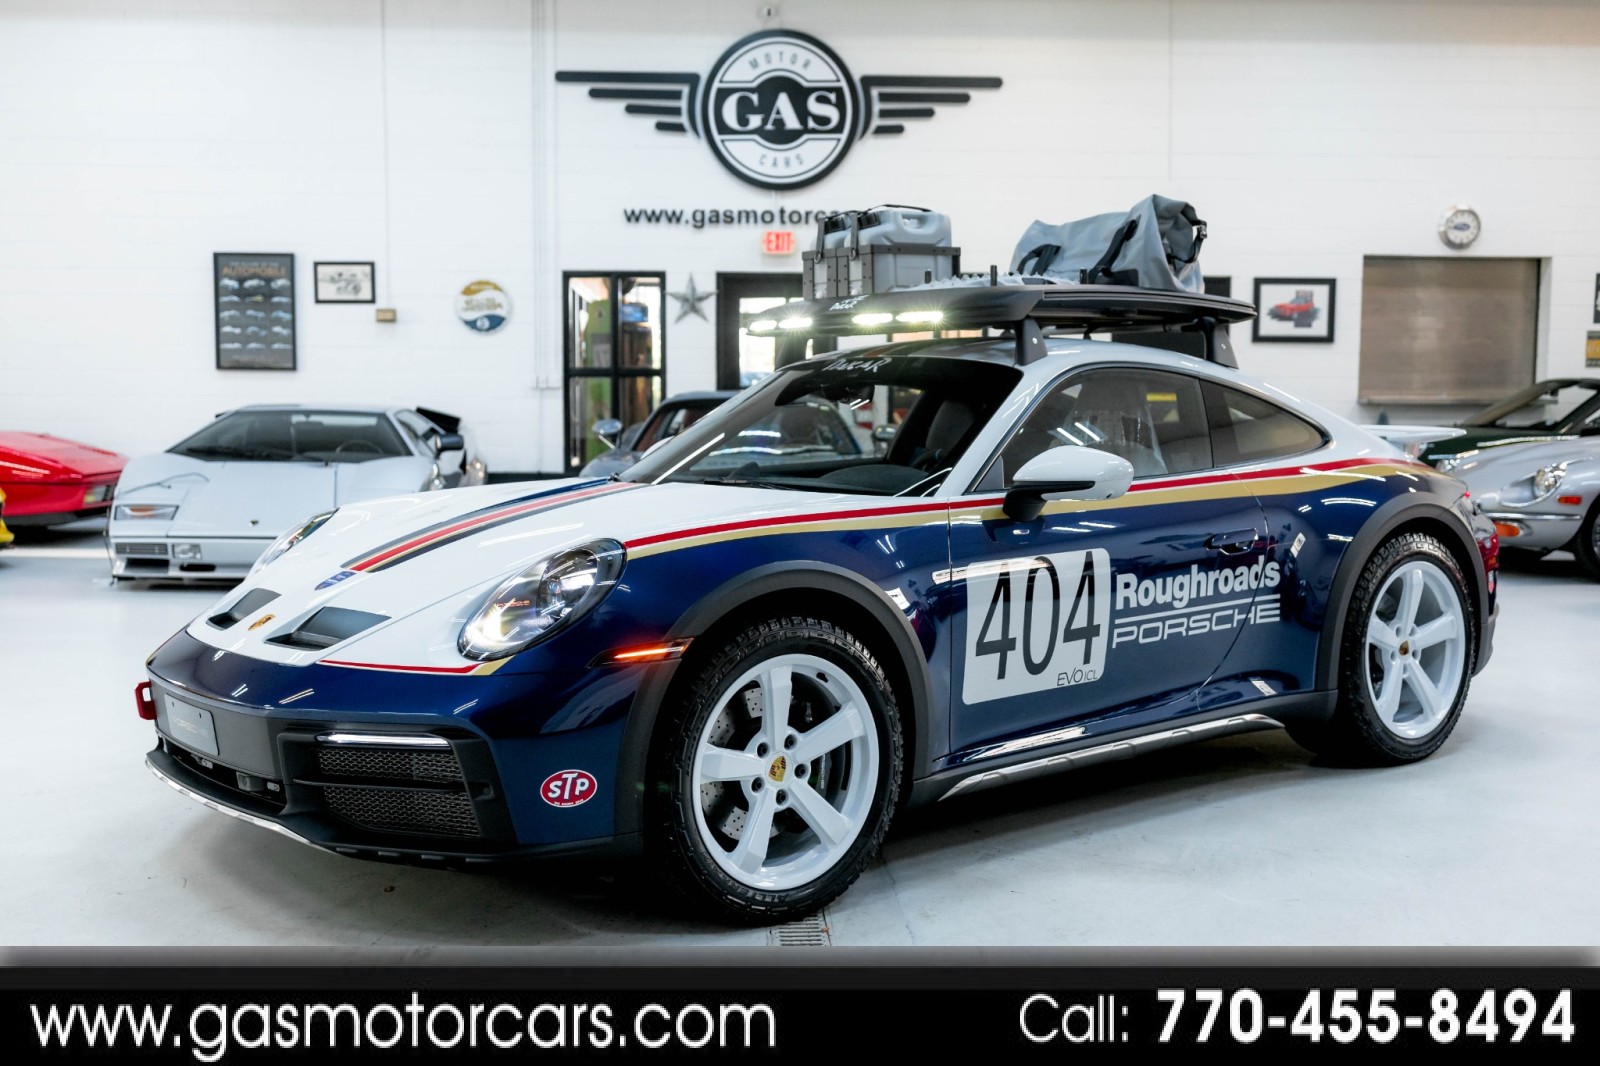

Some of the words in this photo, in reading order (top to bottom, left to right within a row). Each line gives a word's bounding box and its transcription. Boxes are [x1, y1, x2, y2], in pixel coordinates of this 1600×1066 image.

[748, 51, 812, 70] MOTOR
[721, 90, 841, 132] GAS
[758, 153, 805, 168] CARS
[765, 231, 793, 253] EXIT
[1115, 555, 1281, 610] Roughroads
[975, 550, 1101, 681] 404
[1112, 602, 1281, 649] PORSCHE
[1056, 667, 1084, 686] EVO
[547, 772, 590, 800] STP
